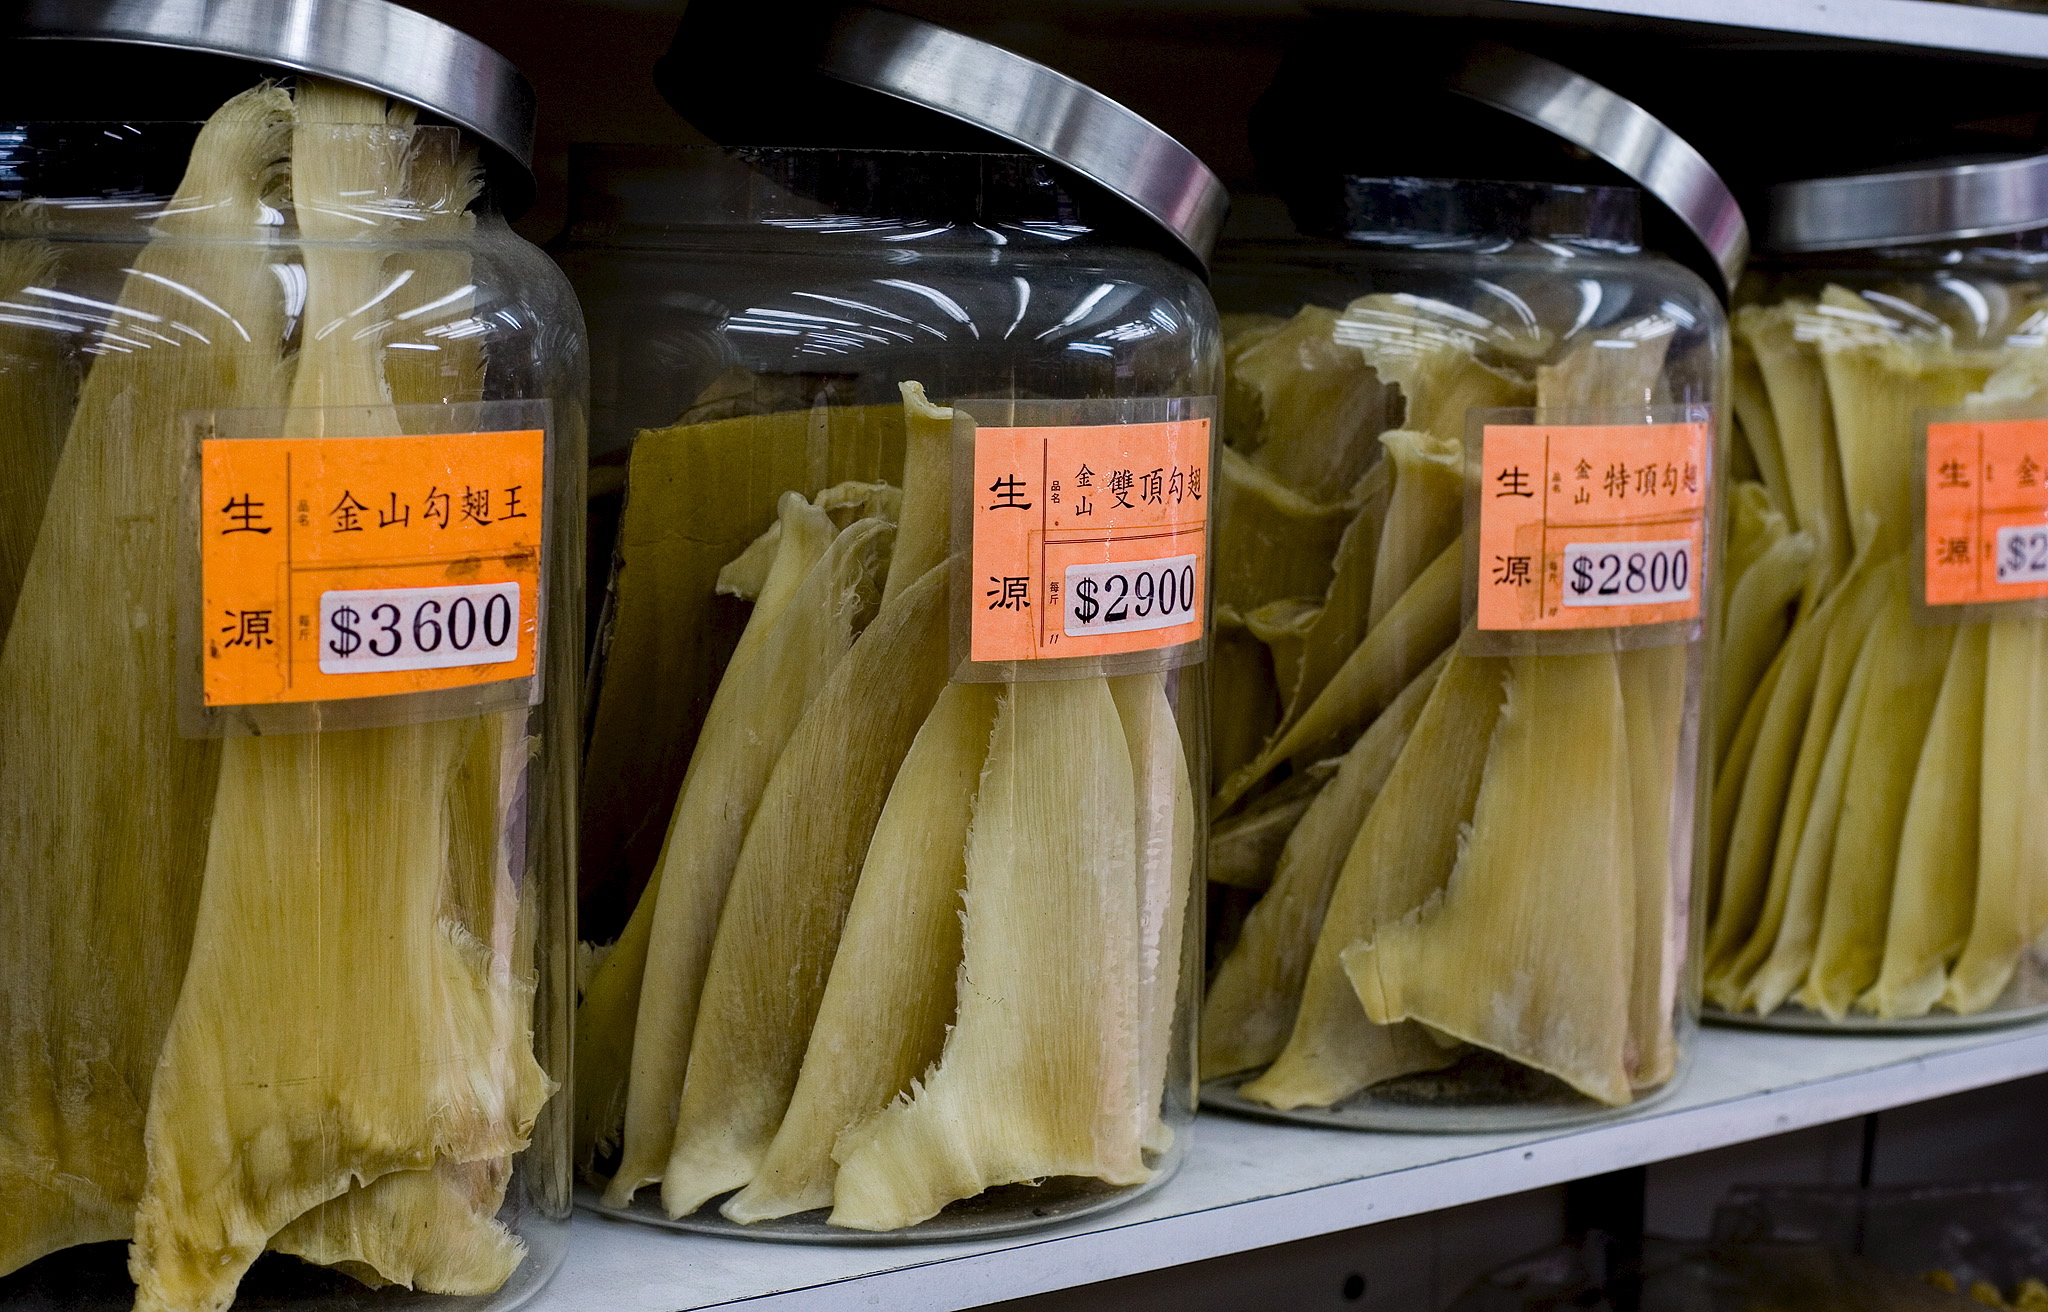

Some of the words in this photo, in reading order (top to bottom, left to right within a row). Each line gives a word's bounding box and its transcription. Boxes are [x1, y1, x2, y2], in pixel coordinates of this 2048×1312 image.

[328, 485, 528, 535] 金山勾翅王
[1050, 480, 1061, 504] 品名
[986, 473, 1032, 612] 生源
[1492, 465, 1535, 587] 生源
[221, 493, 273, 650] 生源
[1074, 564, 1195, 625] $2900
[1571, 549, 1689, 595] $2800
[329, 593, 512, 659] $3600
